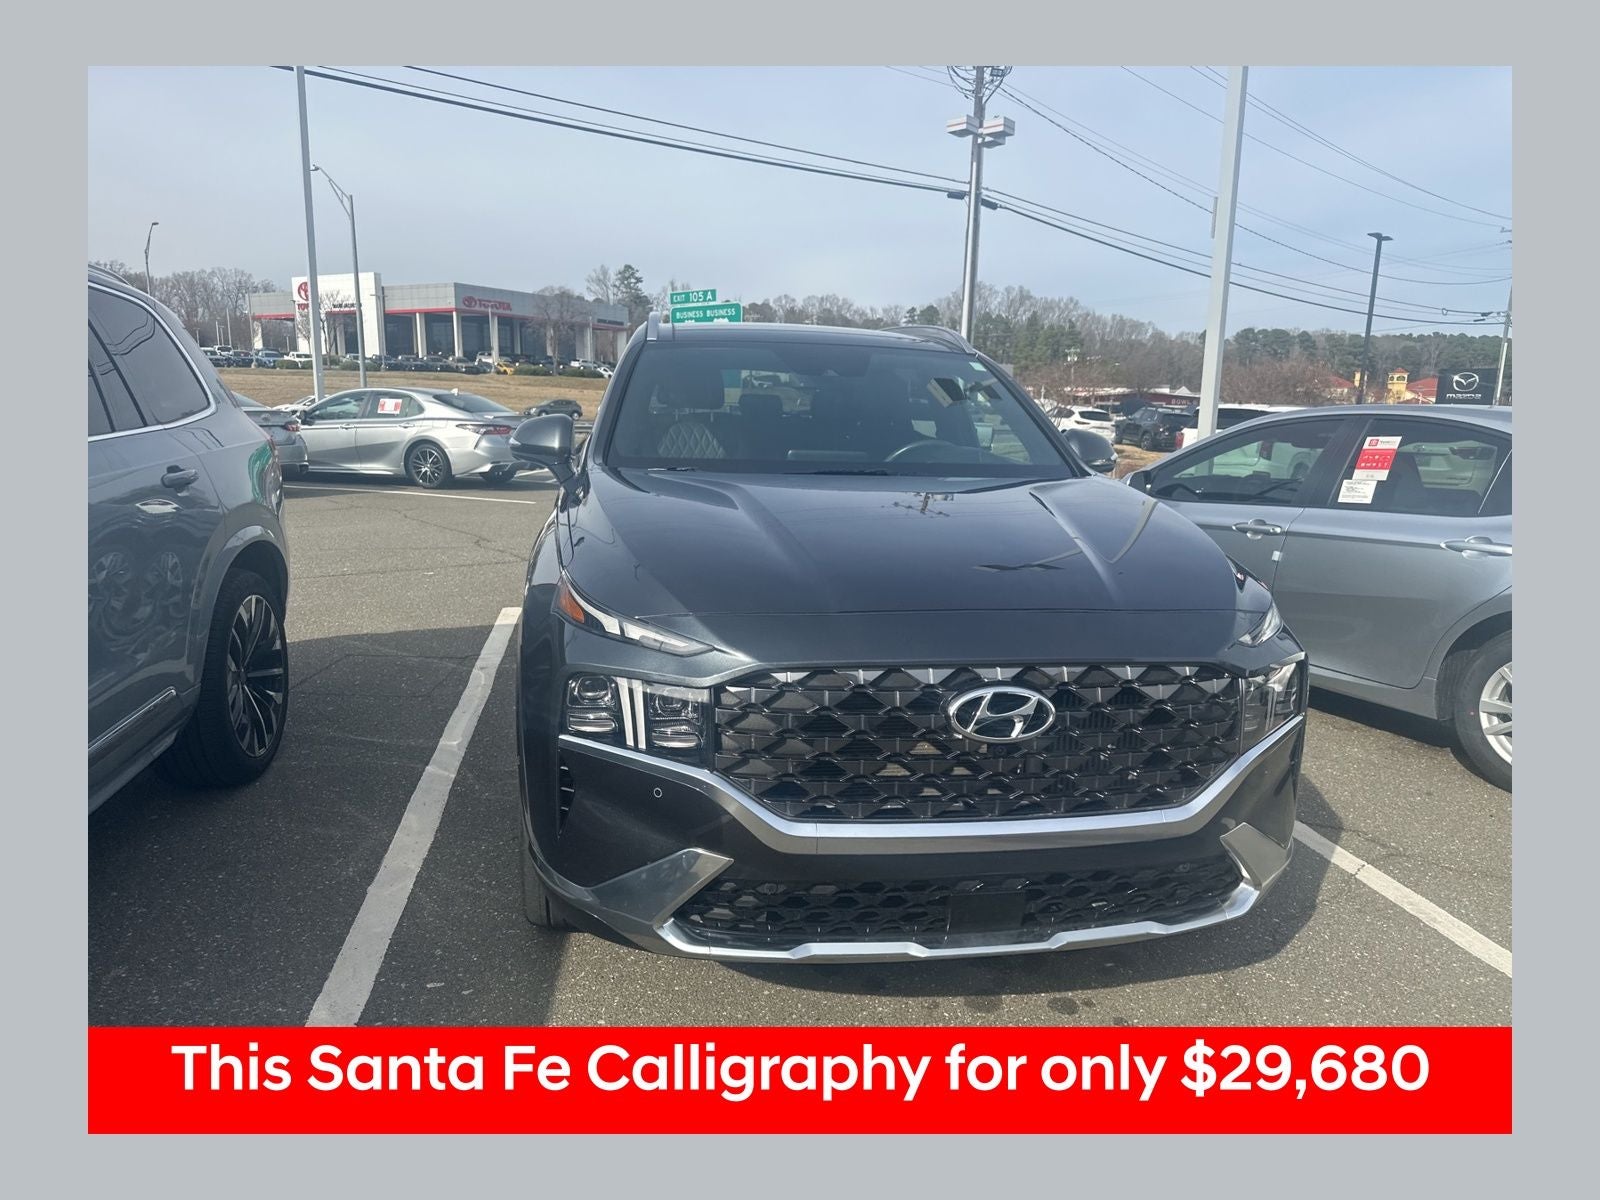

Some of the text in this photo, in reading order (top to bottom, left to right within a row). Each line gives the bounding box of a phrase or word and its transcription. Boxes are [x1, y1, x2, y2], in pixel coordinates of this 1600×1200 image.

[673, 291, 713, 303] EXIT 105 A
[477, 298, 512, 311] TOYOTA
[676, 308, 736, 319] BUSINESS BUSINESS
